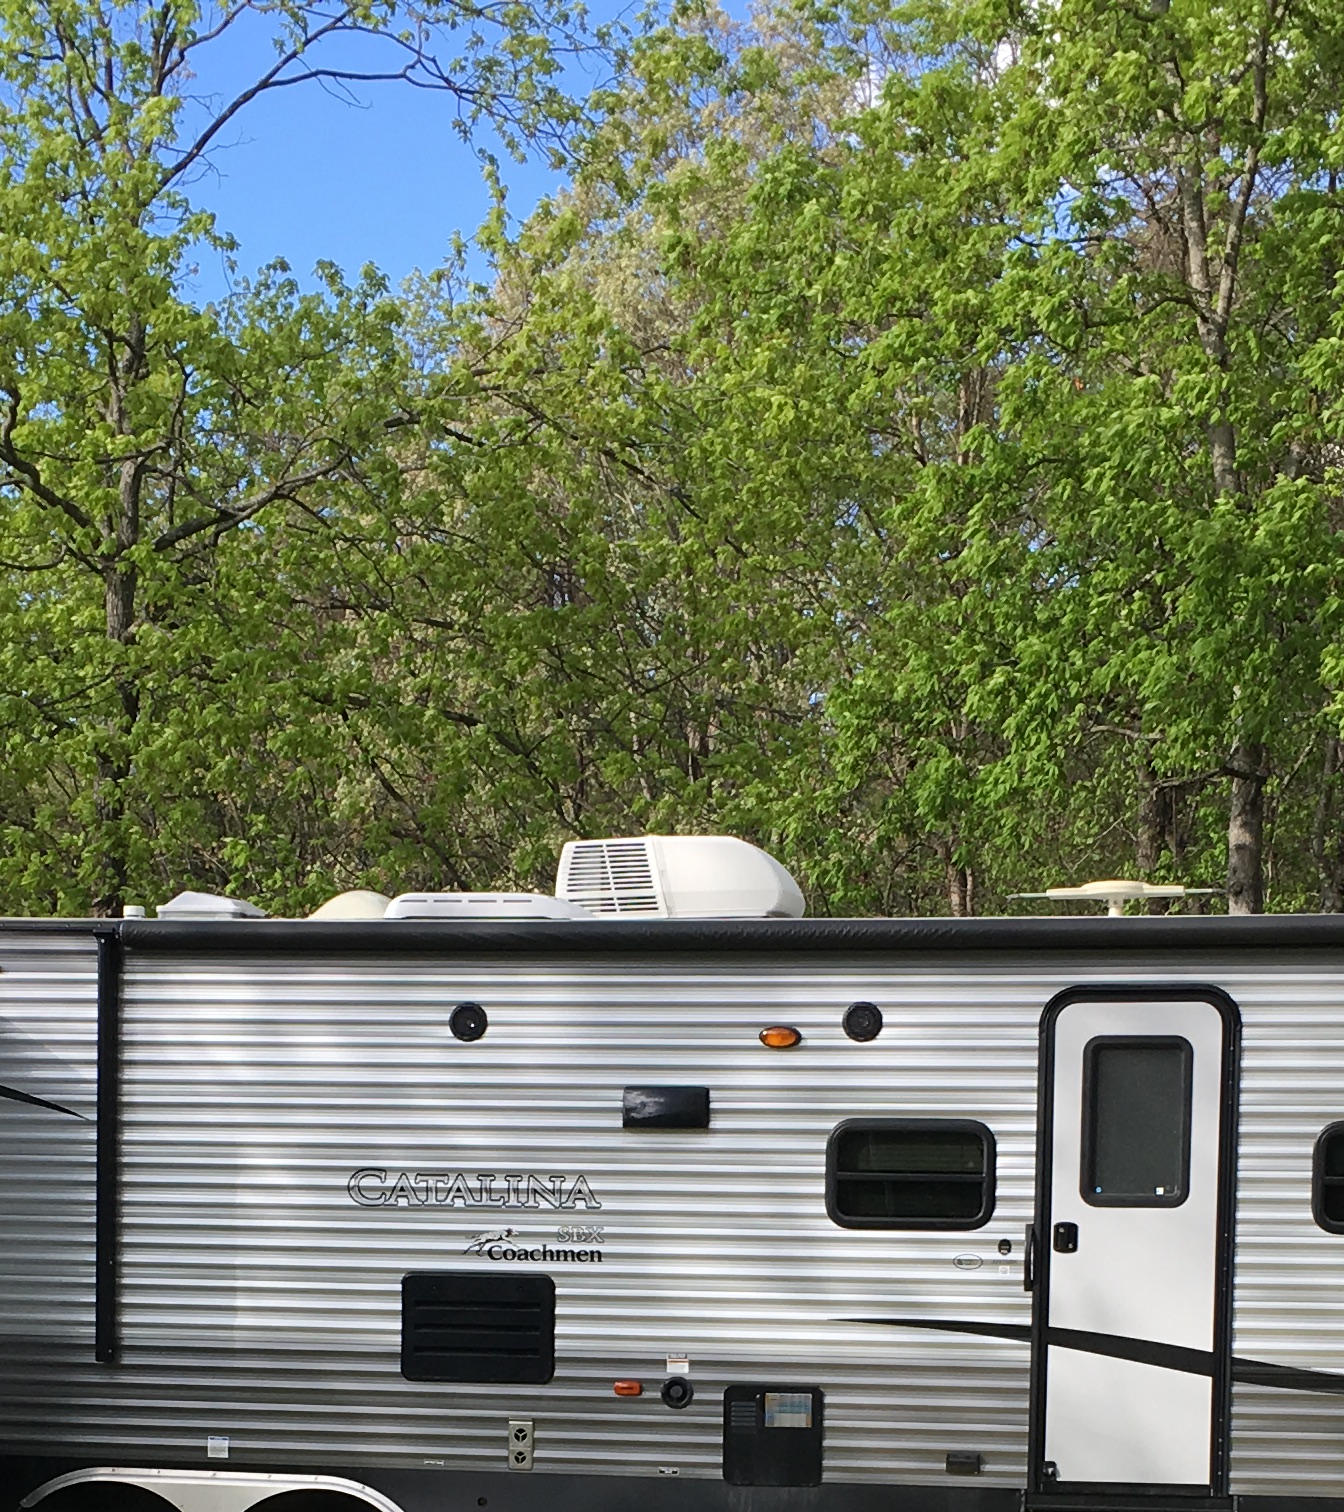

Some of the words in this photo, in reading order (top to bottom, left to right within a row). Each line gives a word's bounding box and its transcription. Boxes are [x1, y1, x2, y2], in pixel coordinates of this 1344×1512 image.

[346, 1167, 602, 1209] CATALINA
[556, 1225, 605, 1244] SBX
[487, 1244, 603, 1263] Coachmen
